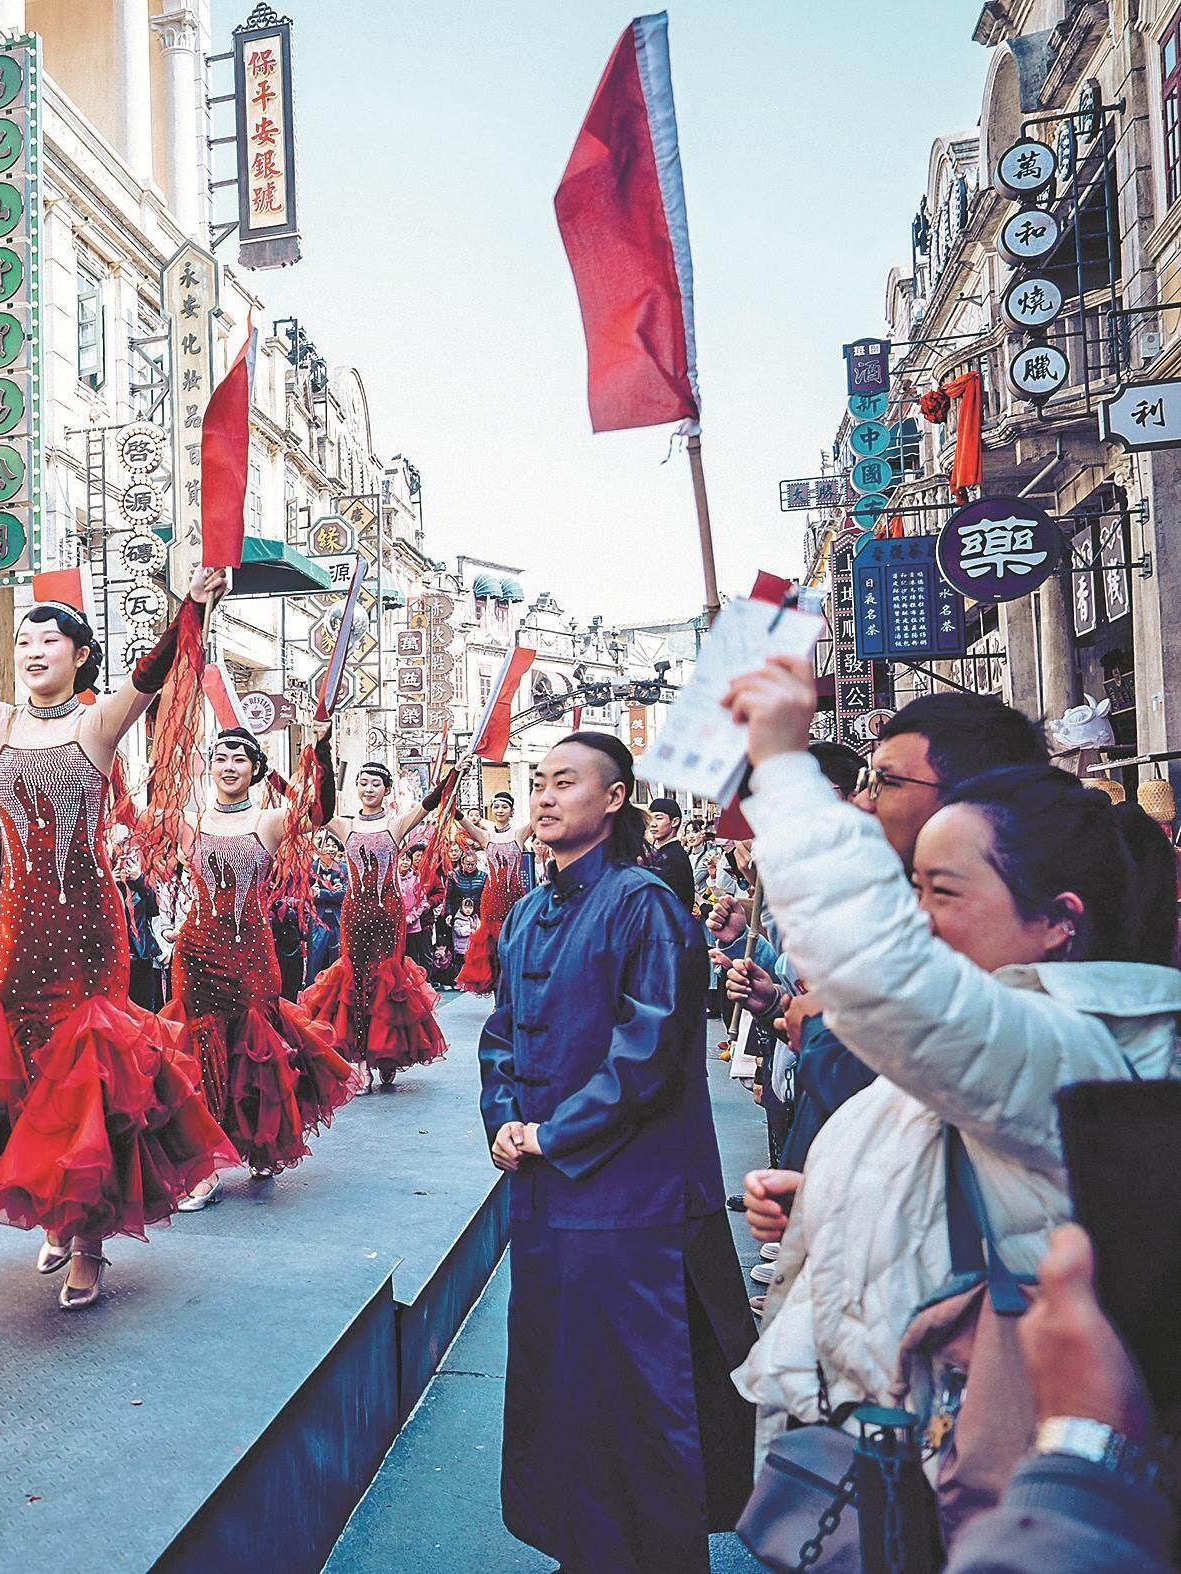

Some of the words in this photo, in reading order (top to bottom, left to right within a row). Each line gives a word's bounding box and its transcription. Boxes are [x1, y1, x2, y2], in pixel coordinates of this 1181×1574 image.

[248, 49, 284, 212] 保平安銀號
[957, 515, 1048, 578] 藥
[864, 579, 880, 636] 日夜名茶
